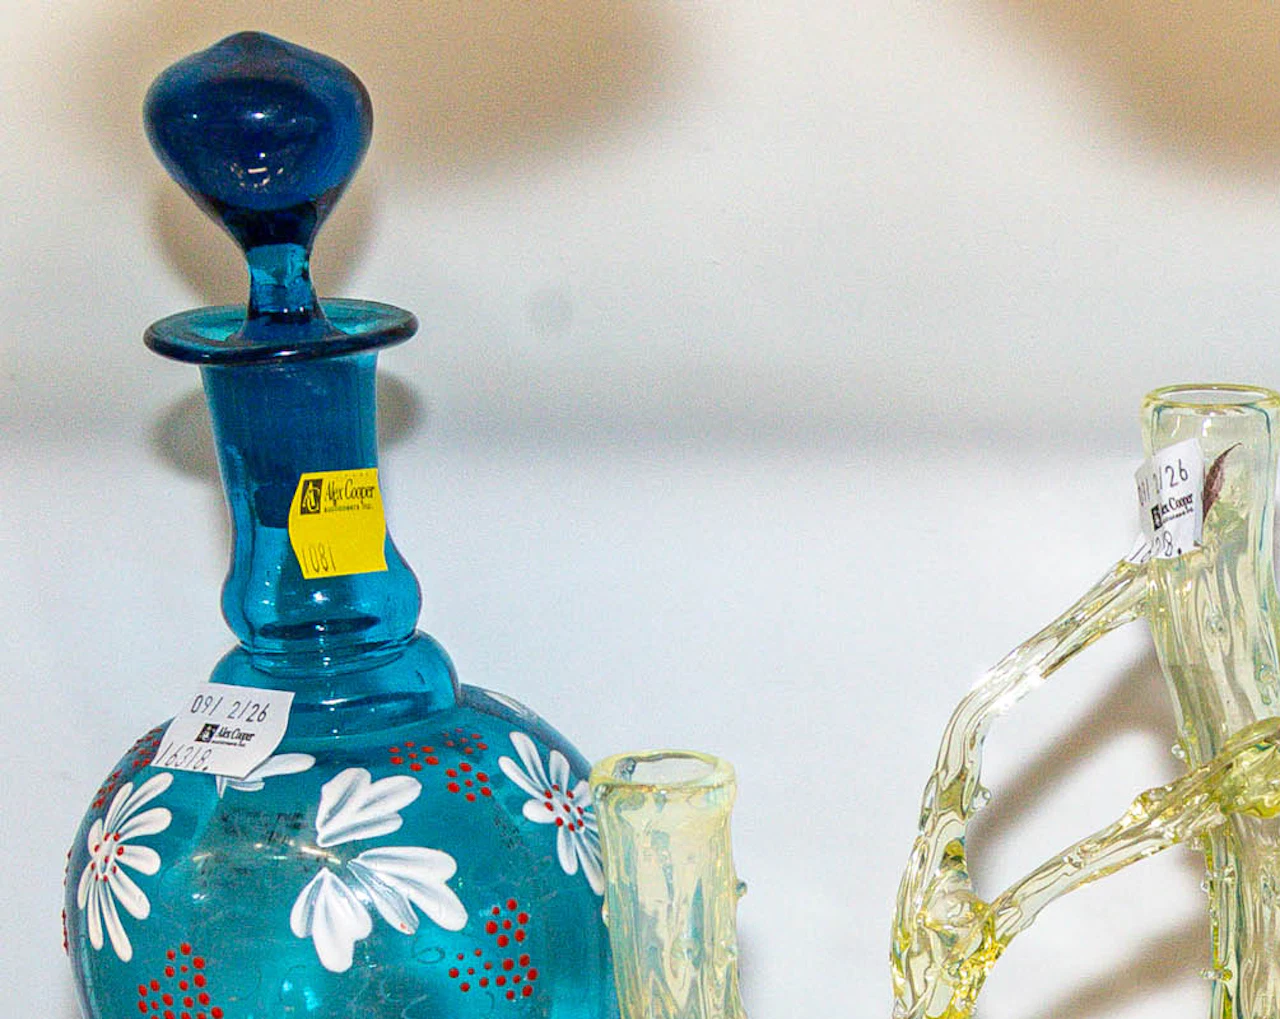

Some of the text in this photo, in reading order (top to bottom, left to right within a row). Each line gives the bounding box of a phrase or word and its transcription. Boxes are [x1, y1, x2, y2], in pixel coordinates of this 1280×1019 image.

[344, 478, 376, 504] Cooper
[302, 542, 337, 575] 1081
[190, 694, 271, 723] 09/ 2/26
